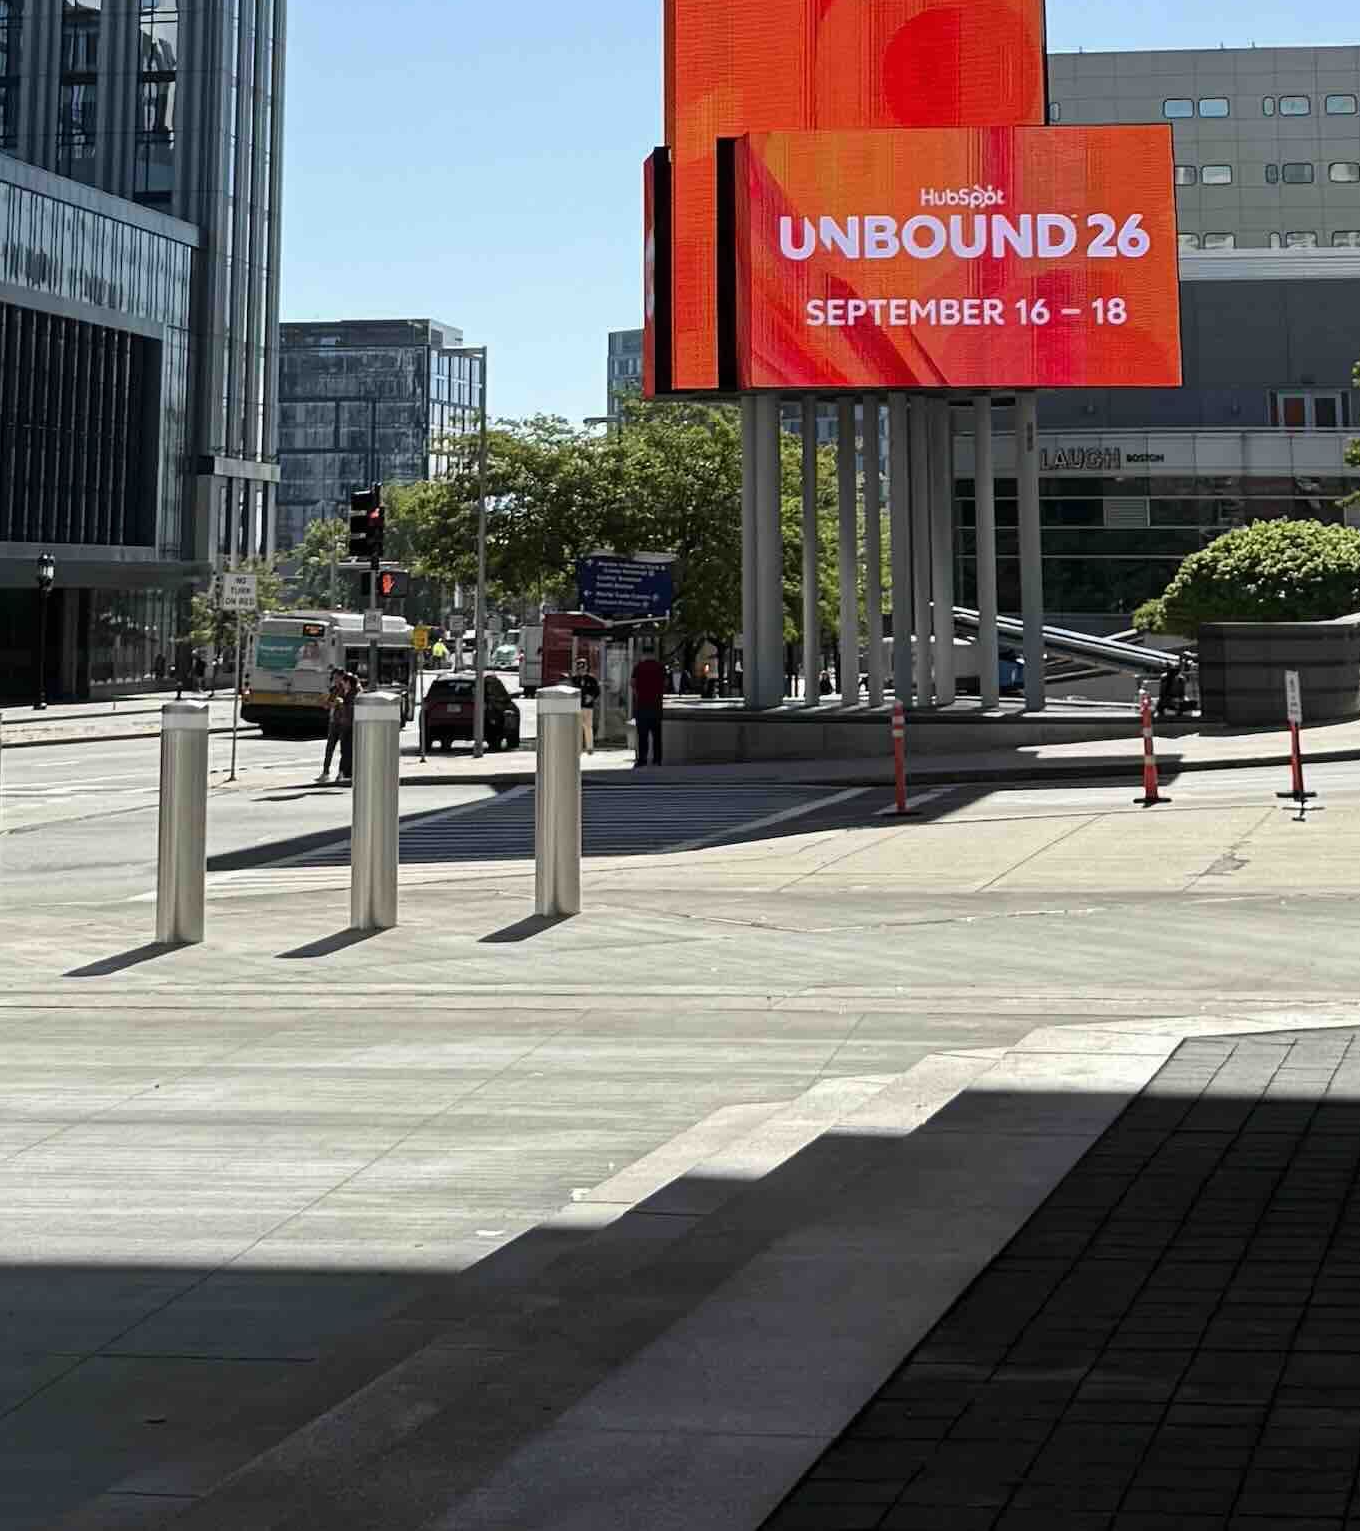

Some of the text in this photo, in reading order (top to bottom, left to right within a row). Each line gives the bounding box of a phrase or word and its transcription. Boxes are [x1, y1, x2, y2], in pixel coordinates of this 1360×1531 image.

[920, 184, 1005, 208] HubSpot
[779, 213, 1150, 260] UNBOUND 26
[806, 299, 1003, 327] SEPTEMBER
[1015, 299, 1050, 325] 16
[1092, 298, 1127, 325] 18
[1040, 447, 1164, 470] LAUGH BOSTON
